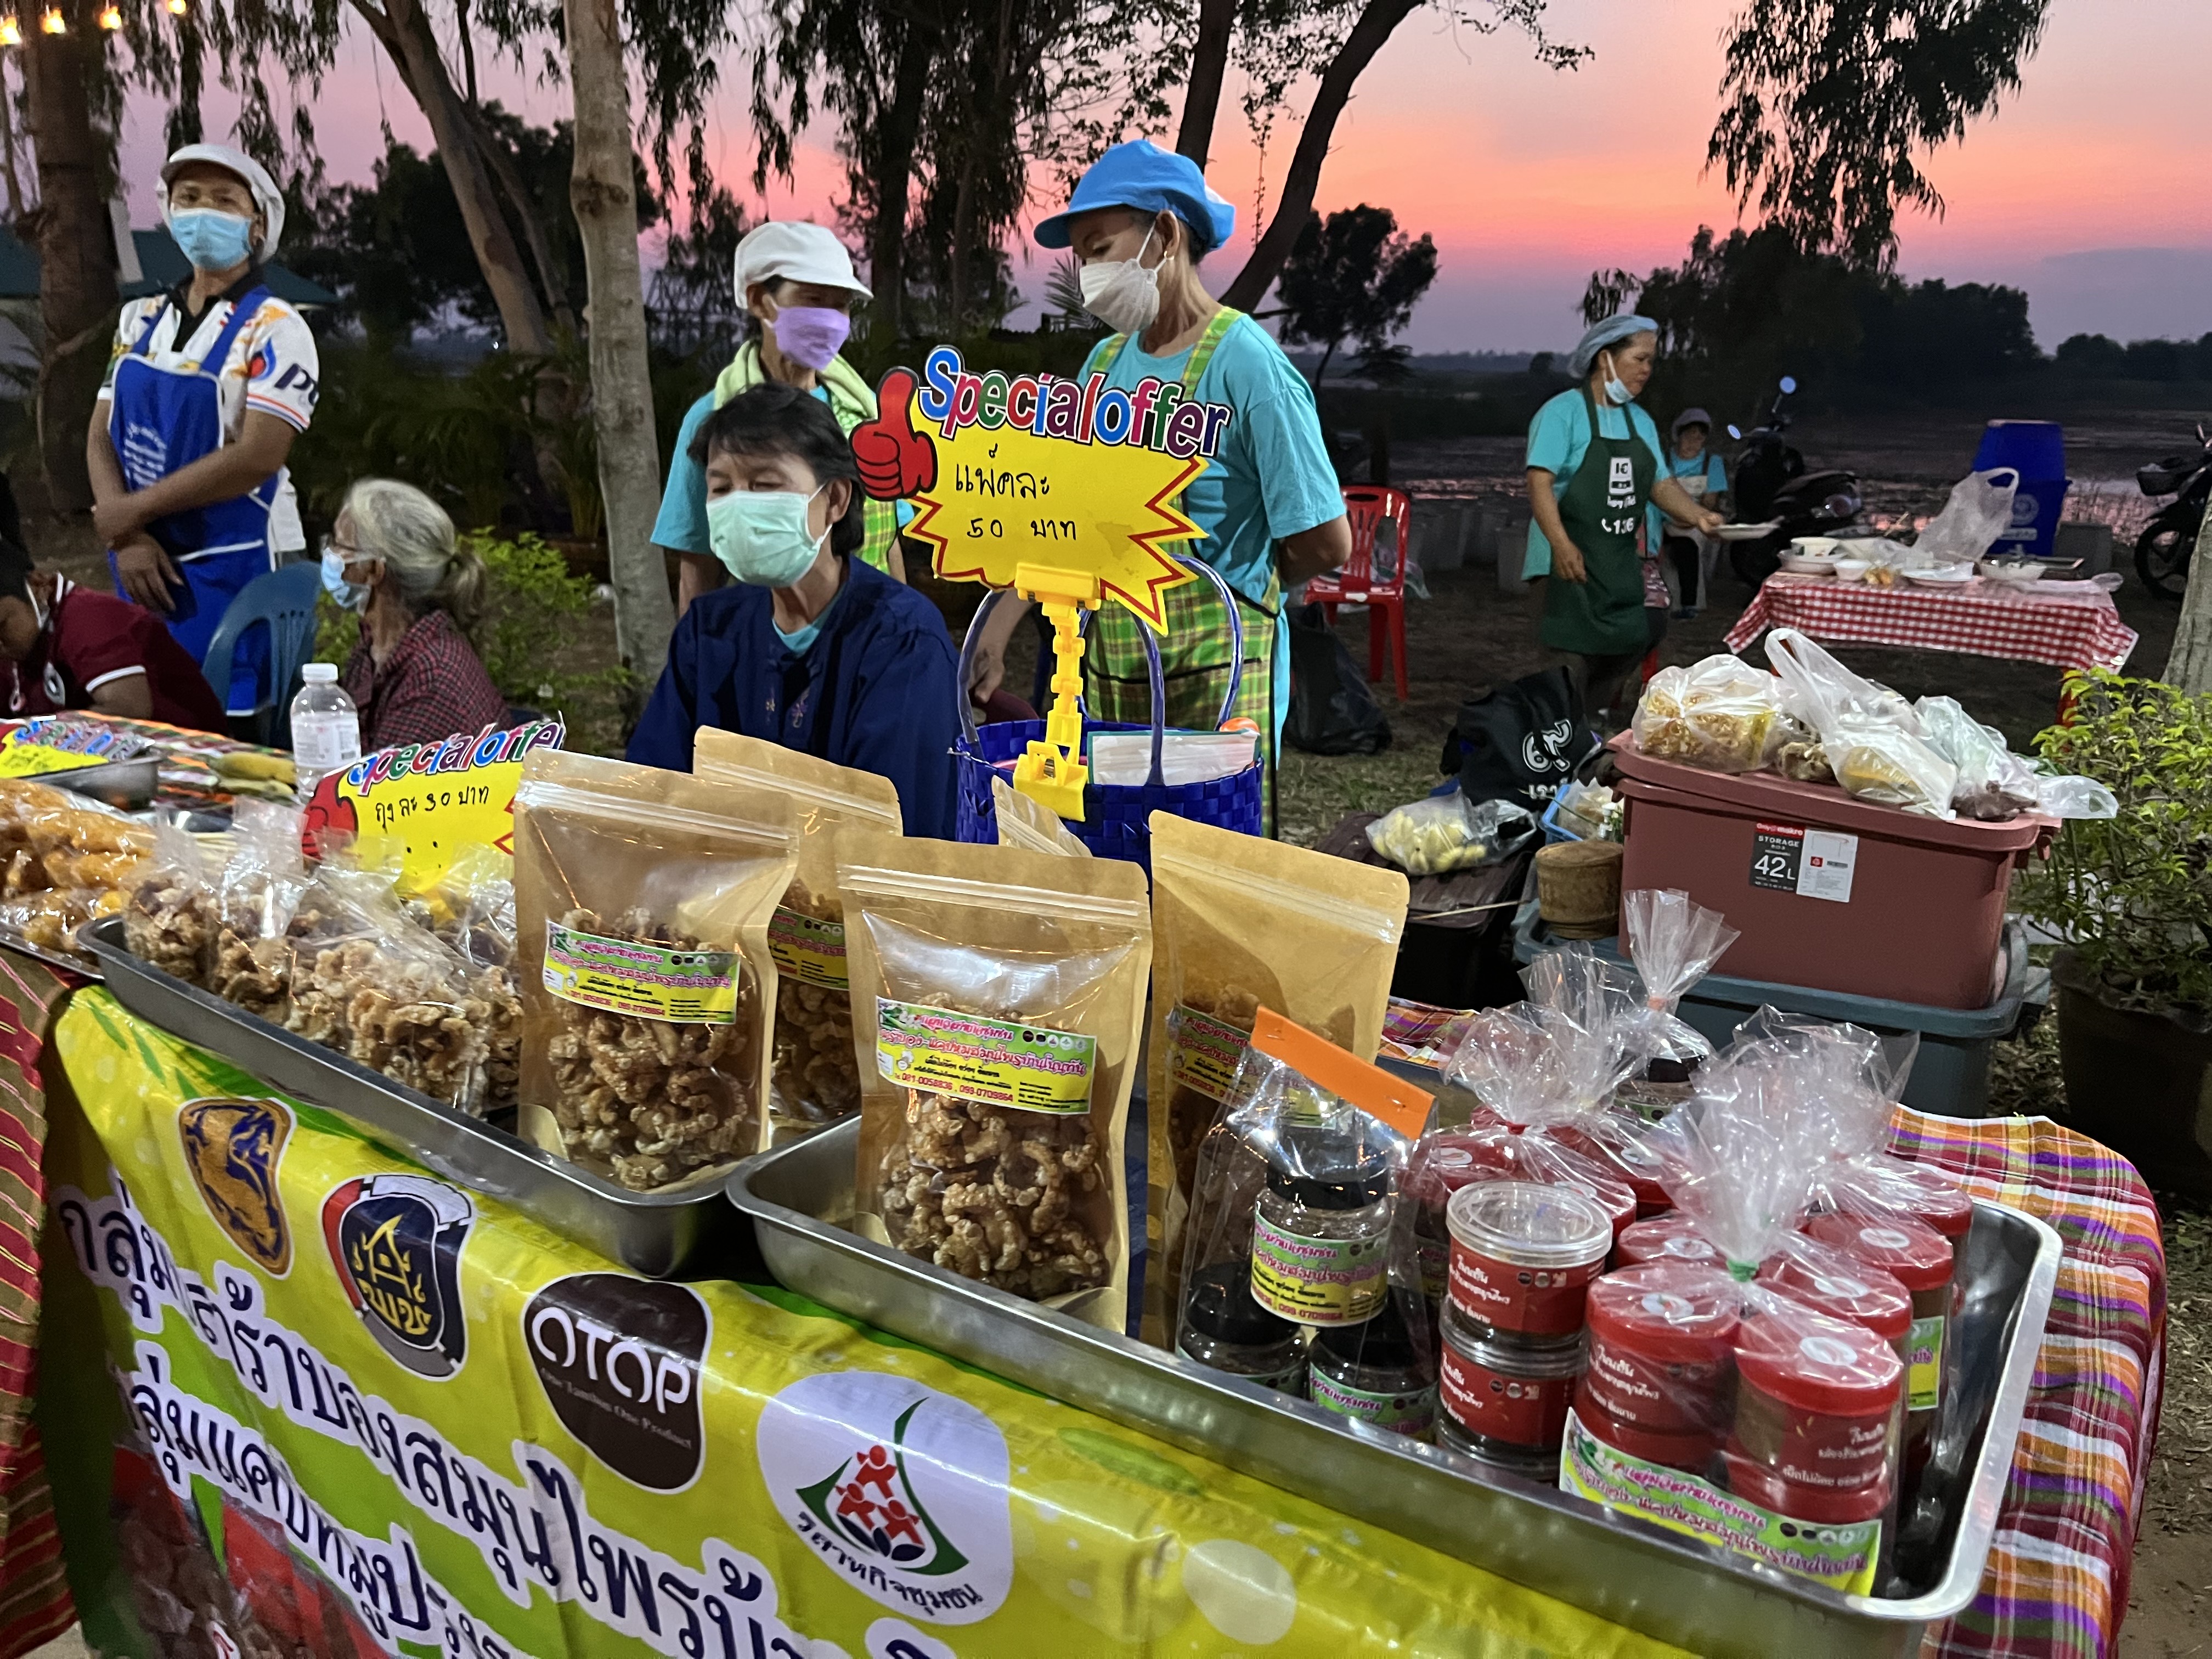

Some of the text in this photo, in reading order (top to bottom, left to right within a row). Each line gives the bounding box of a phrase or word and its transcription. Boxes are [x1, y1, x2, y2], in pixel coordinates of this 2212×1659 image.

[967, 518, 1077, 540] 50 บาท
[458, 786, 489, 805] บาท
[1758, 835, 1799, 848] STORAGE
[1754, 855, 1796, 880] 42 L
[532, 1307, 691, 1413] OTOP
[797, 1511, 984, 1616] วิสาหกิจชุมชน
